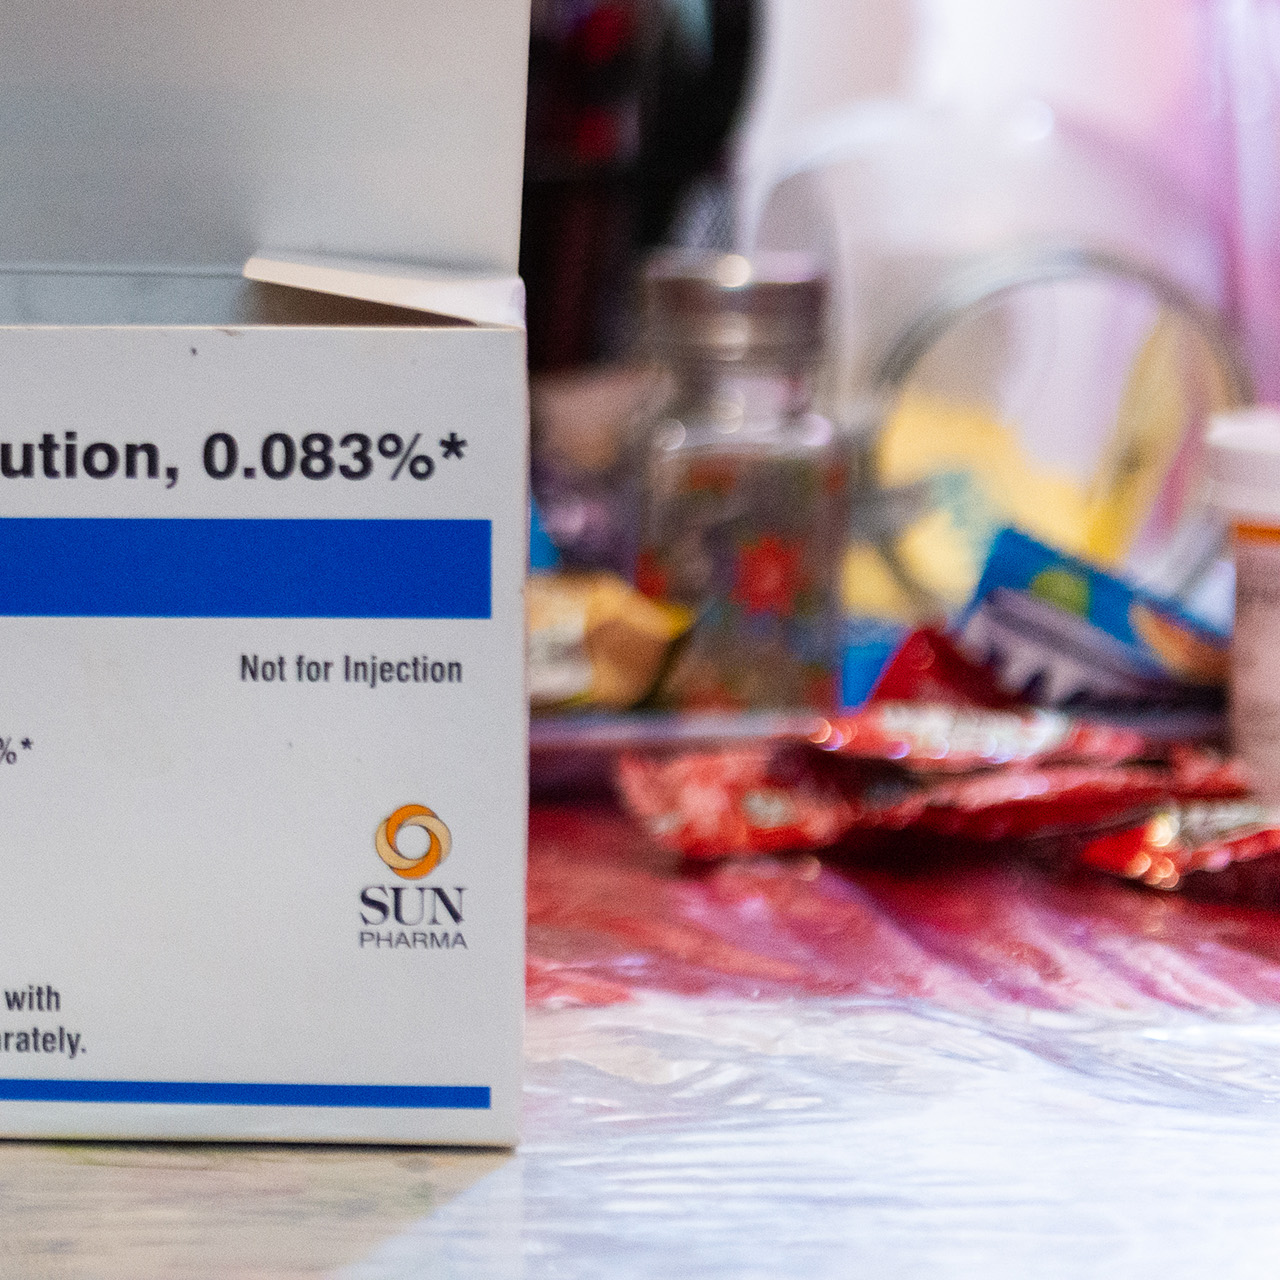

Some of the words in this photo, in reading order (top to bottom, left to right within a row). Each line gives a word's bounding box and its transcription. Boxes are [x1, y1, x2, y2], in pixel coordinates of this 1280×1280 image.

[240, 654, 286, 682] Not
[295, 654, 333, 682] for
[344, 655, 462, 689] Injection
[360, 886, 464, 925] SUN
[359, 930, 468, 949] PHARMA
[4, 985, 60, 1011] with
